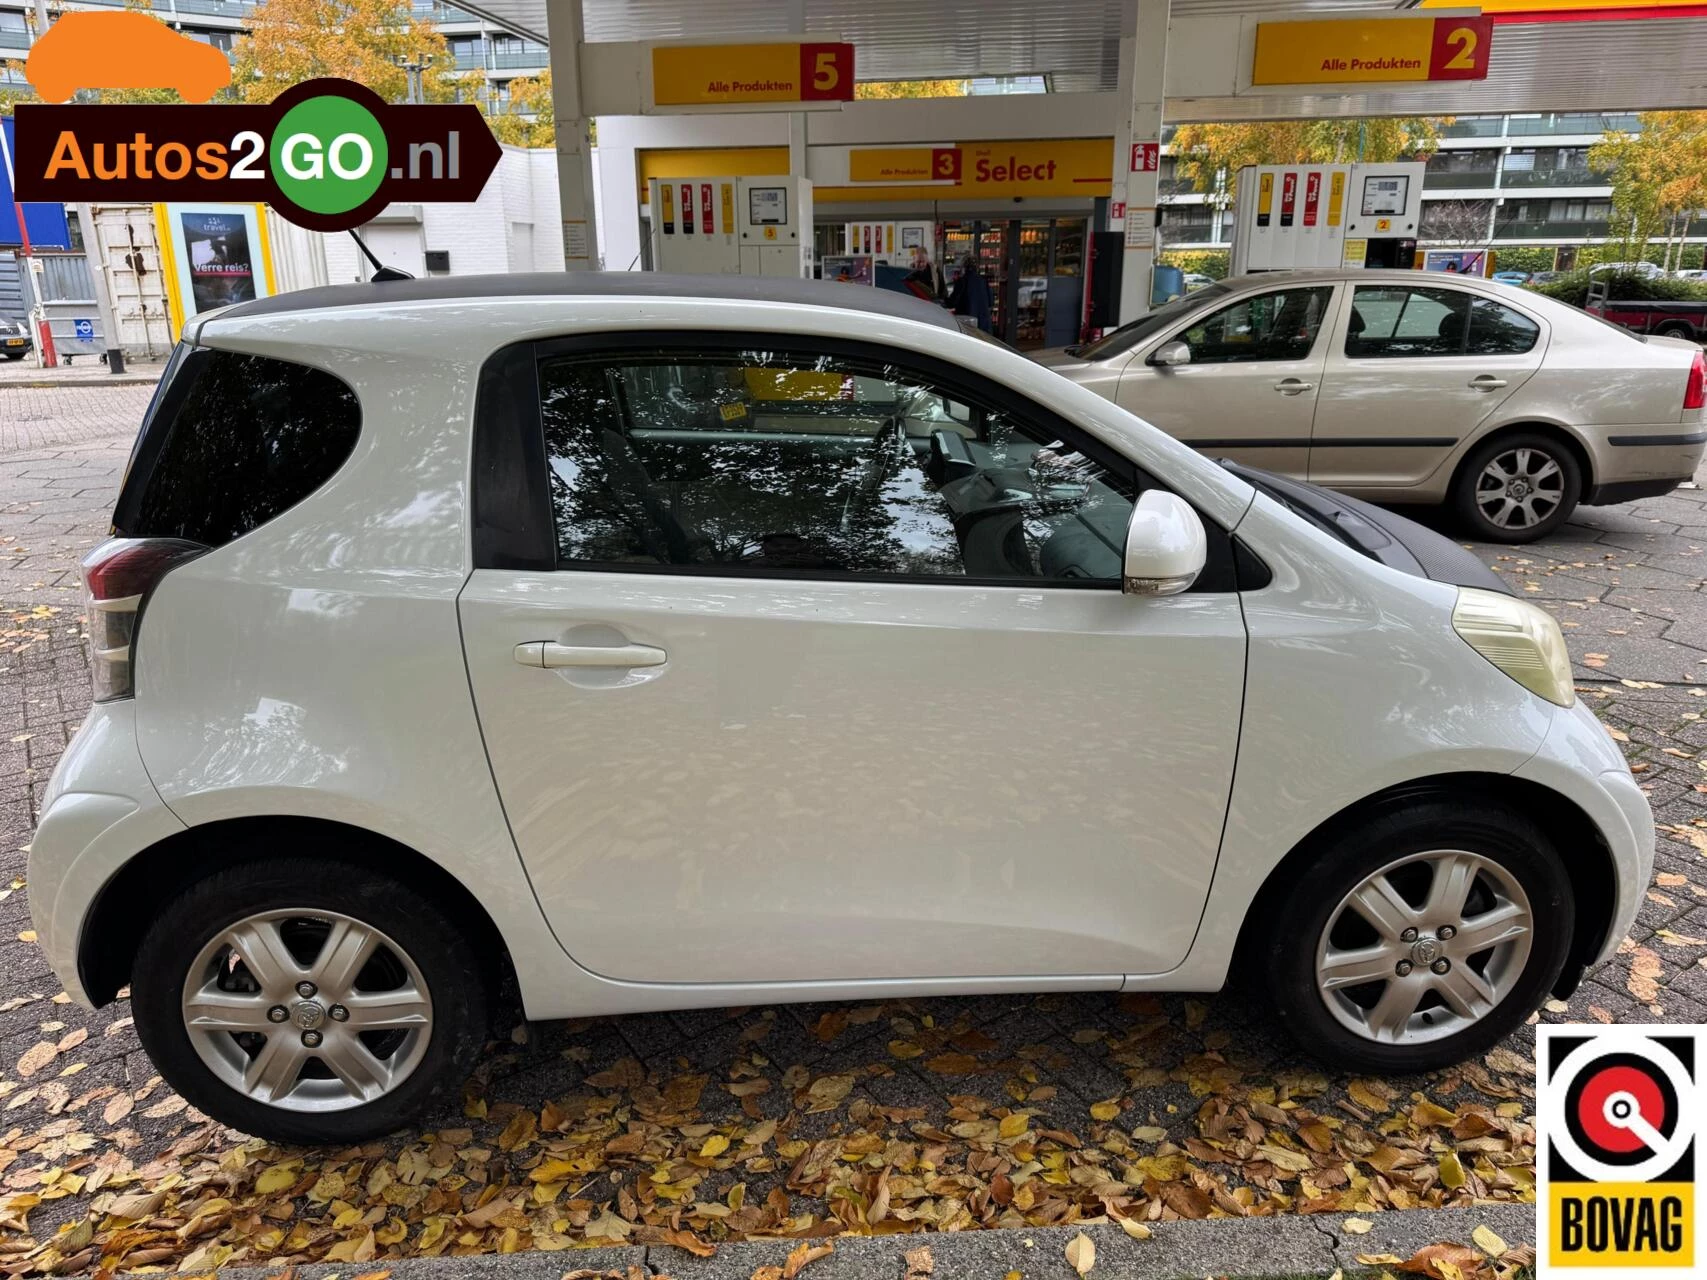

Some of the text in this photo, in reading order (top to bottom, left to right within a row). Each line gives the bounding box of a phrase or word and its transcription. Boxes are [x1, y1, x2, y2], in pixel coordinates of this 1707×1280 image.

[1443, 27, 1477, 69] 2
[814, 53, 838, 90] 5
[1321, 57, 1421, 70] Alle Produkten
[708, 80, 793, 92] Alle Produkten
[939, 154, 954, 175] 3
[976, 156, 1056, 182] Select
[1380, 220, 1387, 229] 2
[225, 262, 249, 272] reis?
